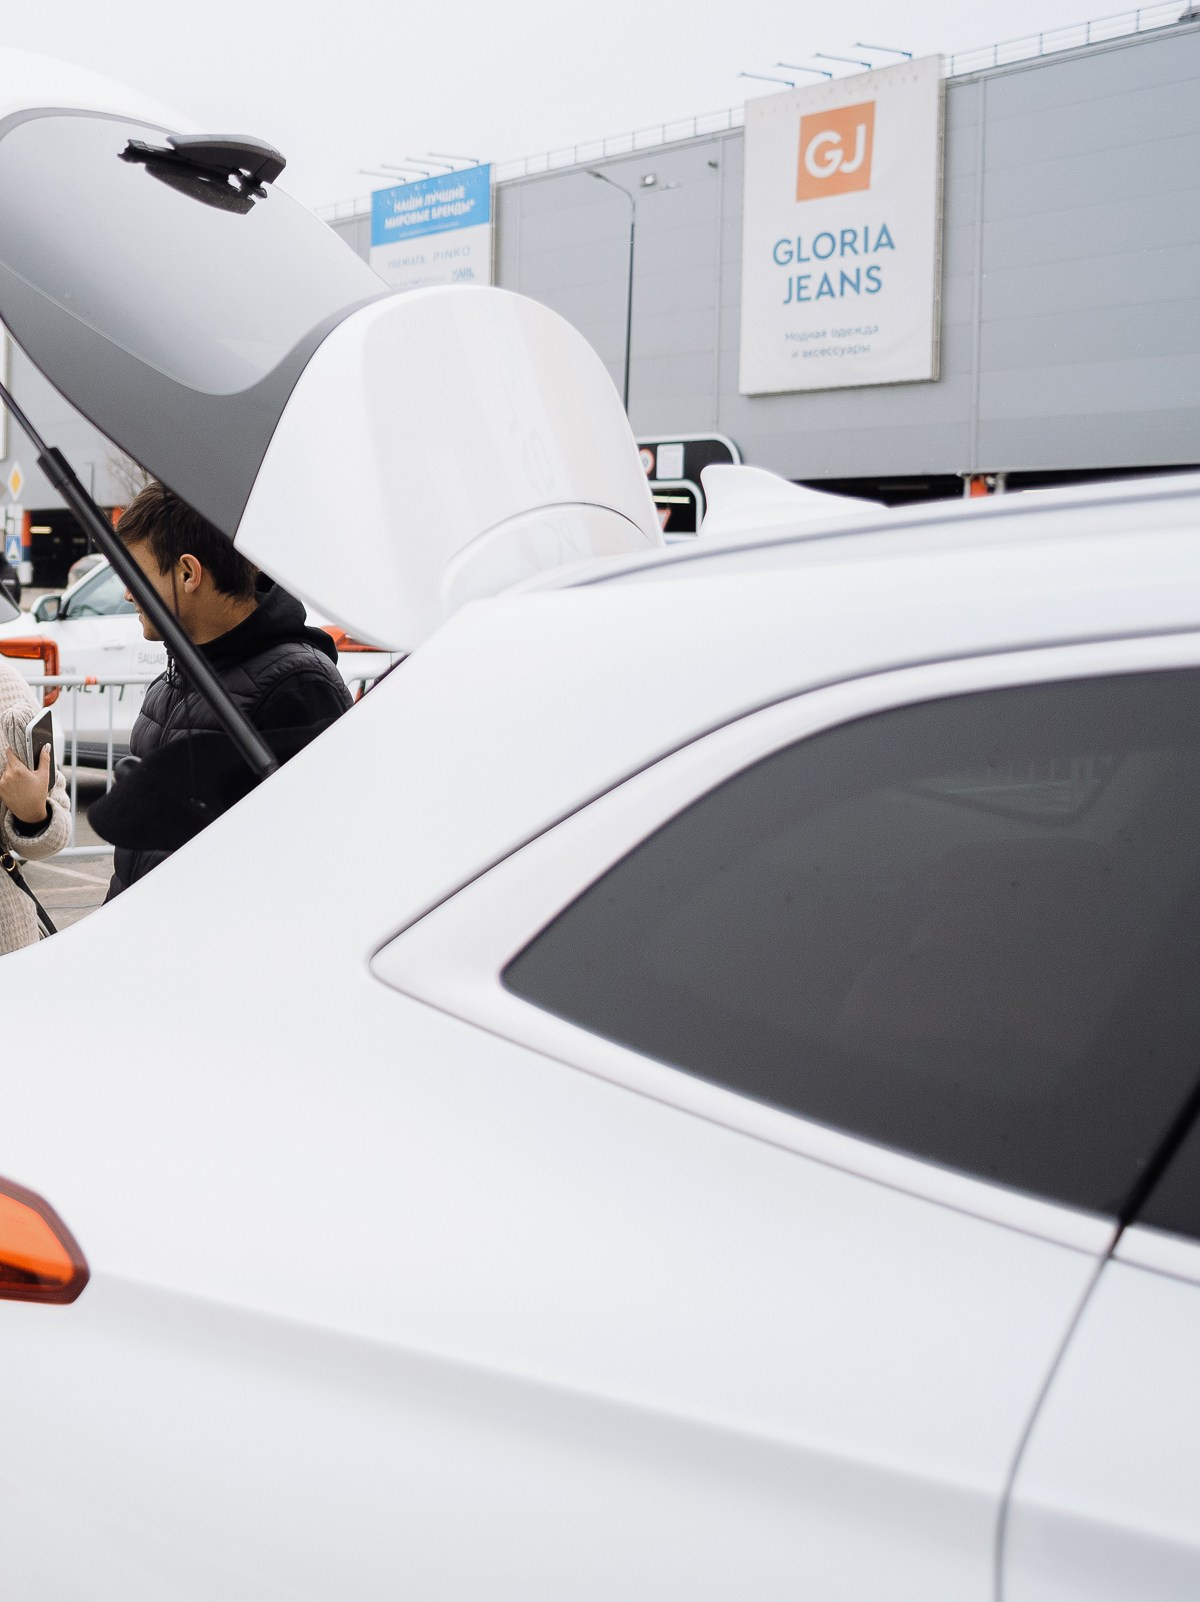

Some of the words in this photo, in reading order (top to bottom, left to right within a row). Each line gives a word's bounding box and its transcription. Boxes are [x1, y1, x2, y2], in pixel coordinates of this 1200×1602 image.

[804, 123, 866, 178] GJ
[393, 196, 423, 213] НАШИ
[424, 185, 465, 206] ЛУЧШИЕ
[384, 210, 430, 230] МИРОВЫЕ
[433, 245, 471, 261] PINKO
[772, 222, 896, 266] GLORIA
[783, 265, 883, 305] JEANS
[784, 328, 827, 342] Модная
[831, 324, 879, 338] одежда
[802, 343, 871, 358] аксессуары
